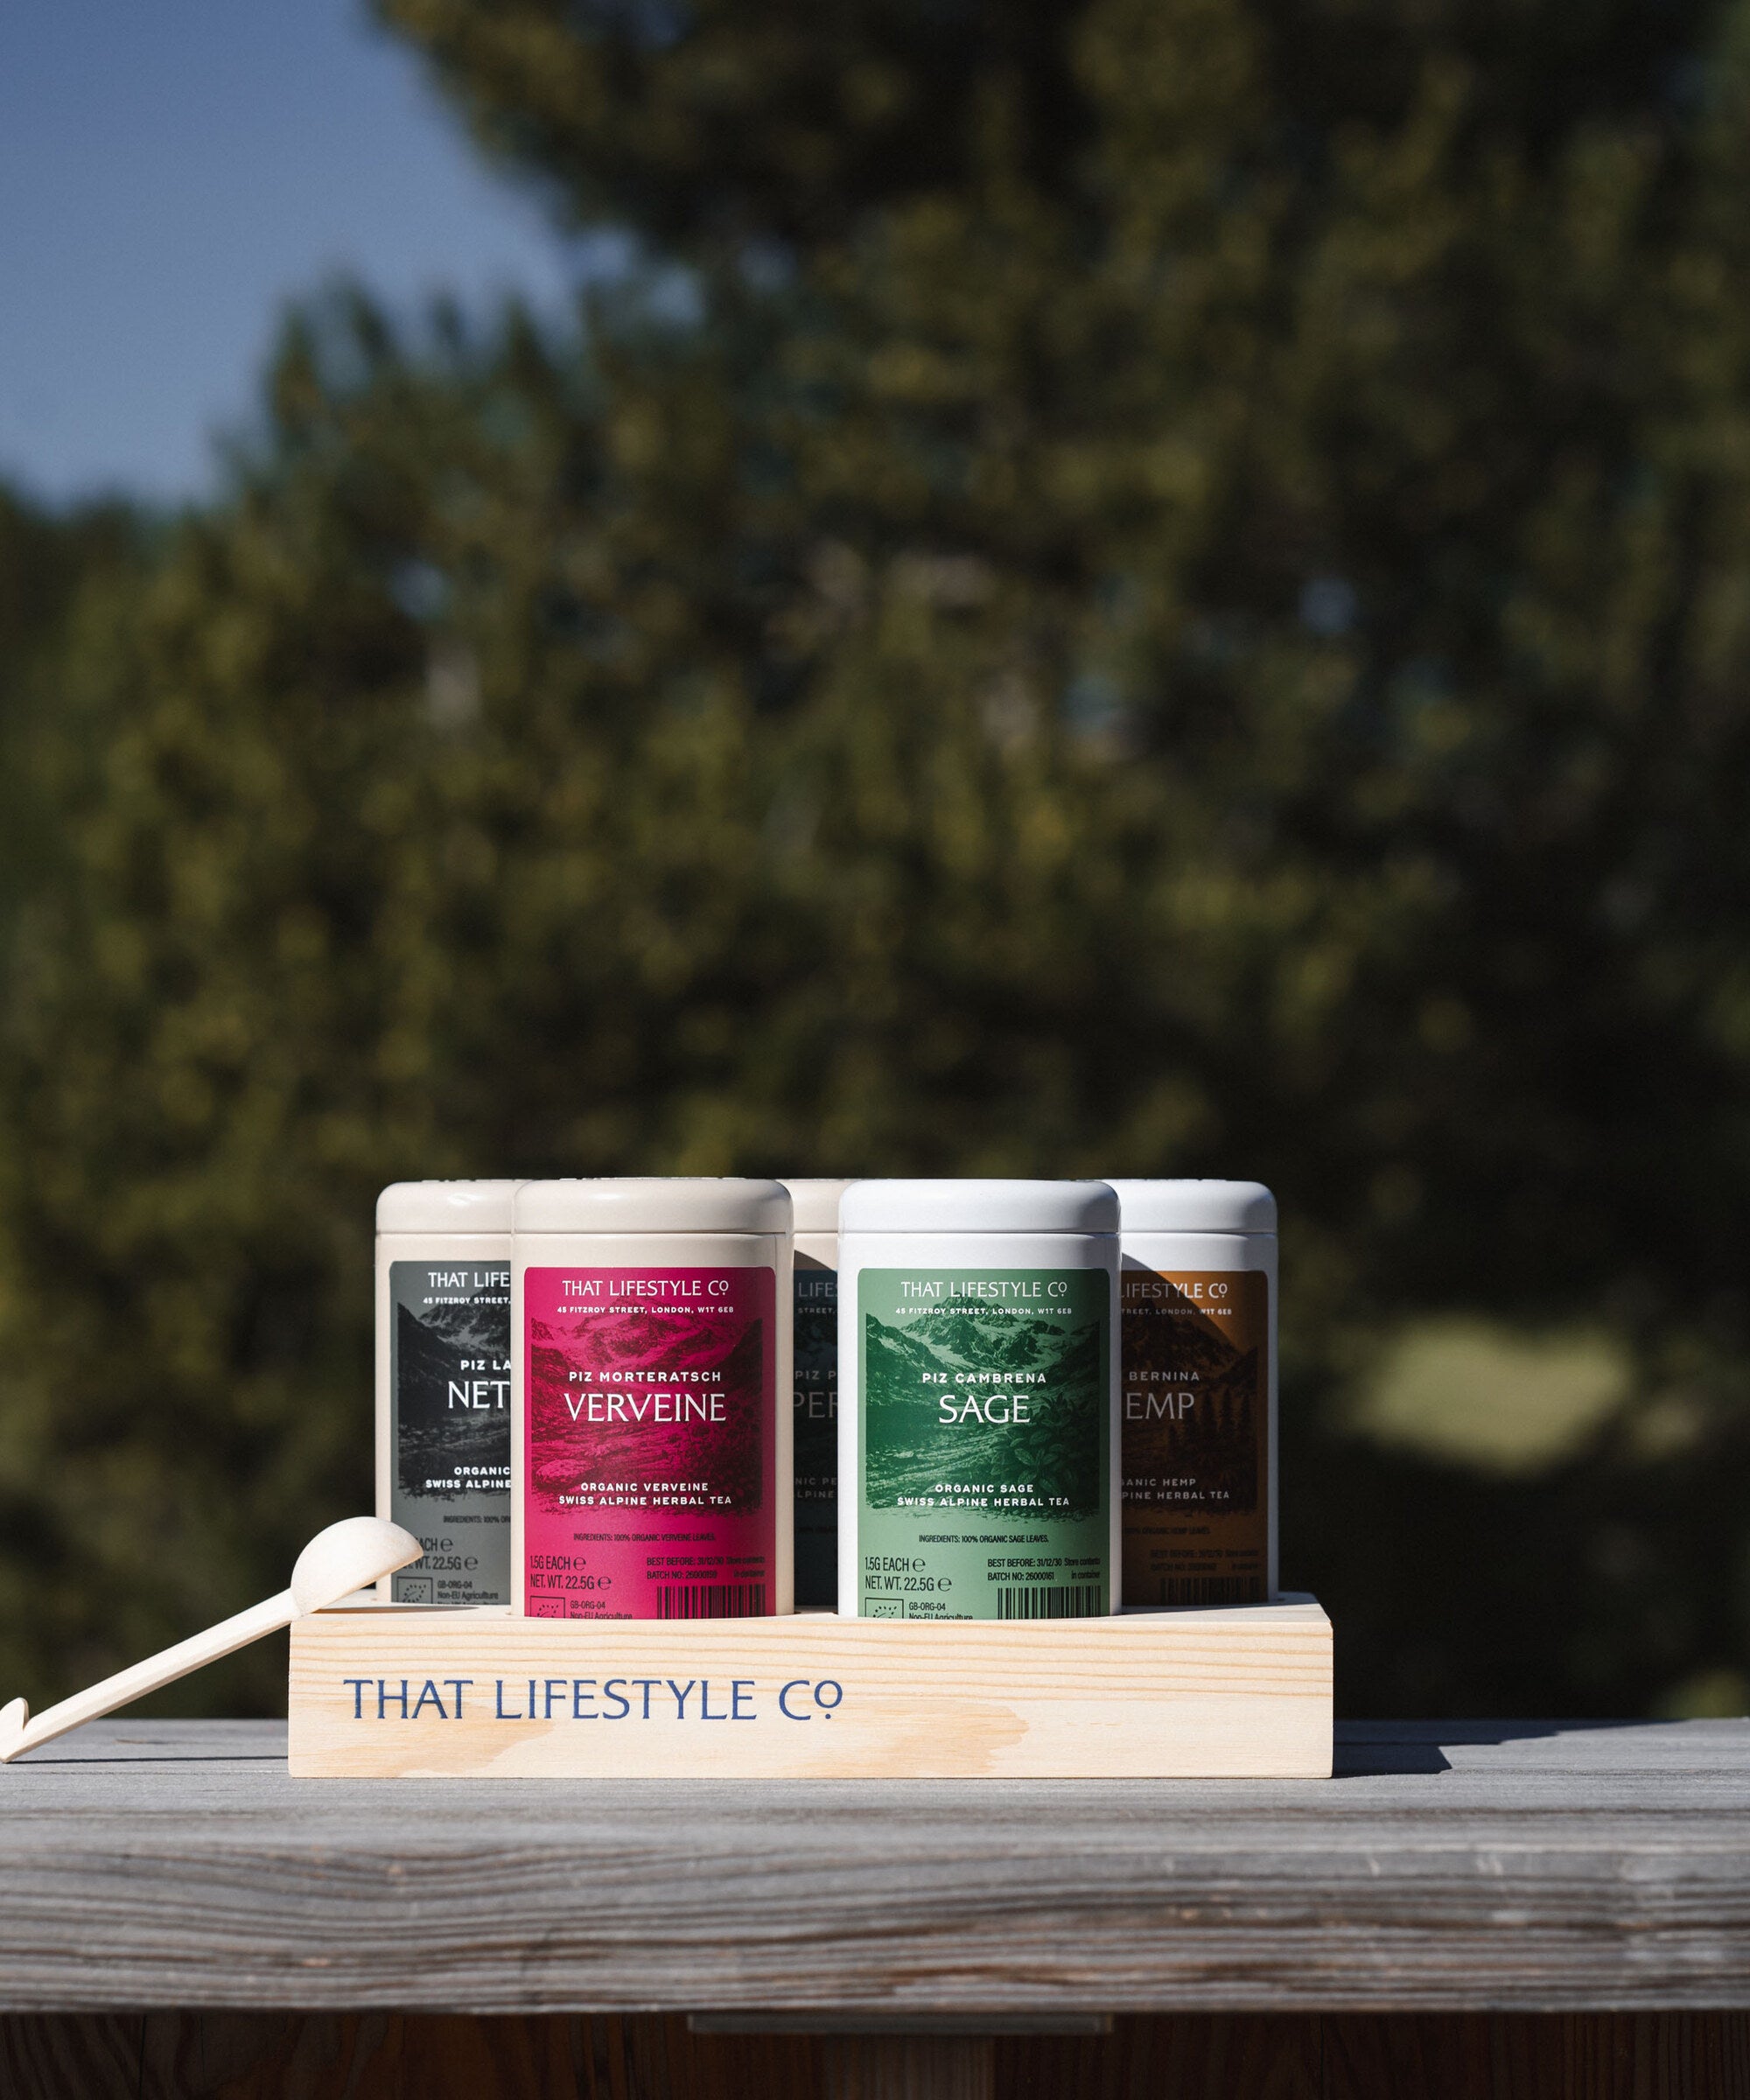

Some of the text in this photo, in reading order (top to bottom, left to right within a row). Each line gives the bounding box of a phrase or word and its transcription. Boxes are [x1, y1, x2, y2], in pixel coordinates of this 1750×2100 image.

[428, 1272, 509, 1287] THAT LIFE
[562, 1280, 603, 1296] THAT
[609, 1280, 702, 1296] LIFESTYLE
[799, 1283, 837, 1297] LIFE
[901, 1281, 943, 1297] THAT
[950, 1281, 1041, 1297] LIFESTYLE
[461, 1360, 511, 1370] PIZ LA
[569, 1371, 721, 1382] PIZ MORTERATSCH
[794, 1370, 820, 1380] PIZ
[922, 1373, 1046, 1383] PIZ CAMBRENA
[1129, 1371, 1200, 1381] BERNINA
[448, 1381, 510, 1409] NET
[564, 1393, 726, 1422] VERVEINE
[939, 1395, 1030, 1424] SAGE
[1126, 1392, 1194, 1419] EMP
[454, 1466, 510, 1475] ORGANIC
[425, 1480, 511, 1488] SWISS ALPINE
[581, 1482, 709, 1492] ORGANIC VERVEINE
[934, 1484, 1034, 1493] ORGANIC SAGE
[559, 1495, 594, 1505] SWISS
[599, 1496, 647, 1505] ALPINE
[653, 1496, 704, 1505] HERBAL
[897, 1497, 934, 1507] SWISS
[940, 1497, 988, 1507] ALPINE
[994, 1498, 1044, 1507] HERBAL
[632, 1533, 660, 1542] ORGANIC
[662, 1533, 691, 1542] VERVEINE
[433, 1556, 461, 1570] 22.5G
[546, 1556, 570, 1570] EACH
[865, 1557, 880, 1570] 1.5G
[883, 1558, 909, 1572] EACH
[988, 1558, 1005, 1567] BEST
[1007, 1558, 1036, 1567] BEFORE:
[647, 1571, 670, 1579] BATCH
[530, 1573, 546, 1588] NET.
[547, 1574, 564, 1589] WT.
[565, 1575, 595, 1590] 22.5G
[865, 1575, 882, 1589] NET.
[885, 1576, 901, 1590] WT.
[904, 1577, 934, 1591] 22.5G
[570, 1600, 606, 1609] GB-ORG-04
[343, 1679, 473, 1719] THAT
[494, 1679, 756, 1719] LIFESTYLE
